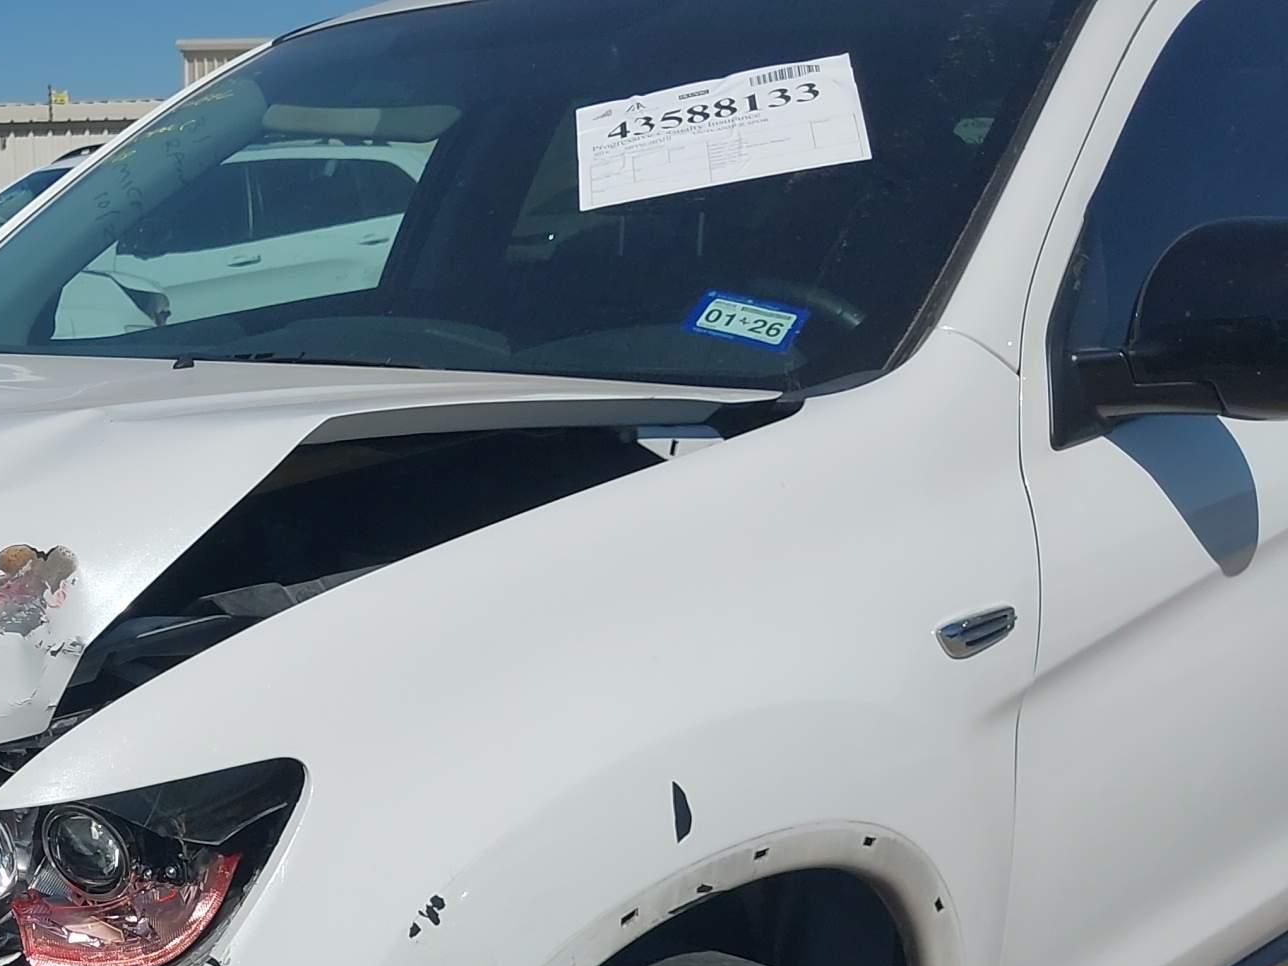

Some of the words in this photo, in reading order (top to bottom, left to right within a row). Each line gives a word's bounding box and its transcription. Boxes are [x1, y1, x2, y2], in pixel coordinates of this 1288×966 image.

[608, 82, 819, 139] 43588133
[705, 309, 737, 326] 01
[747, 319, 785, 338] 26
